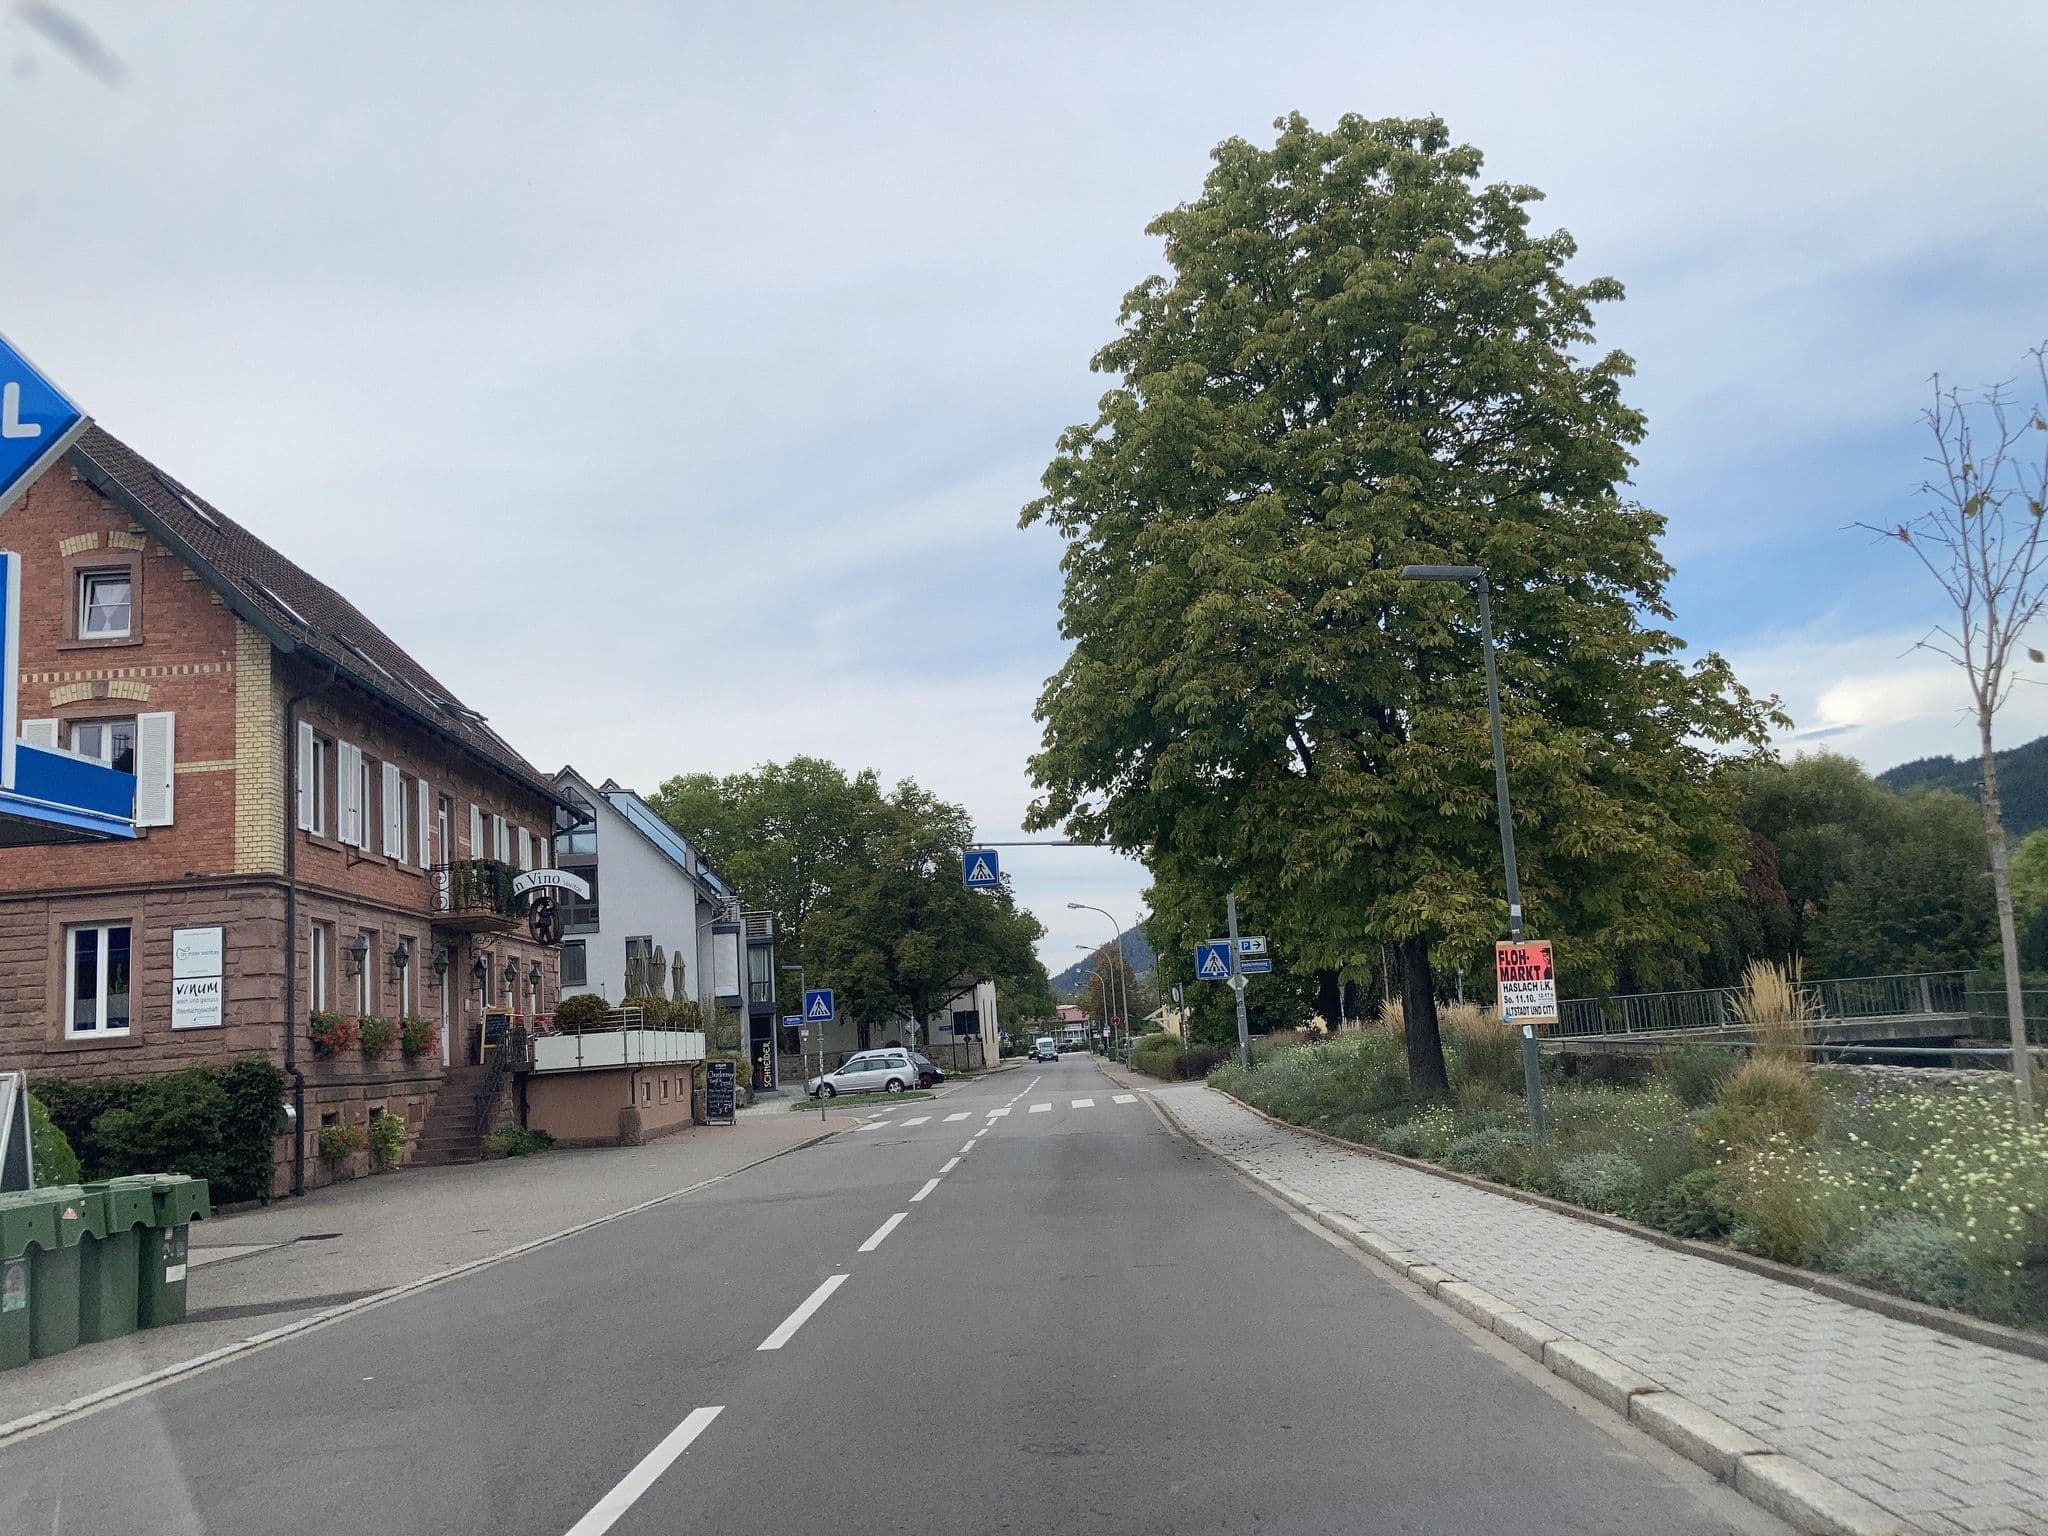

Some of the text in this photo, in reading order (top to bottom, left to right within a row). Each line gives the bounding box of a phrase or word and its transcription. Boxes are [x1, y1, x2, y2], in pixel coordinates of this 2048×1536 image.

[527, 872, 560, 885] Vino
[1498, 950, 1529, 965] FLOH-
[1500, 966, 1540, 981] MARKT
[1503, 982, 1538, 992] HASLACH
[1516, 994, 1537, 1003] 11.10.
[1506, 1005, 1554, 1016] ALTSTADT UND CITY
[762, 1040, 772, 1088] SCHNEIDER
